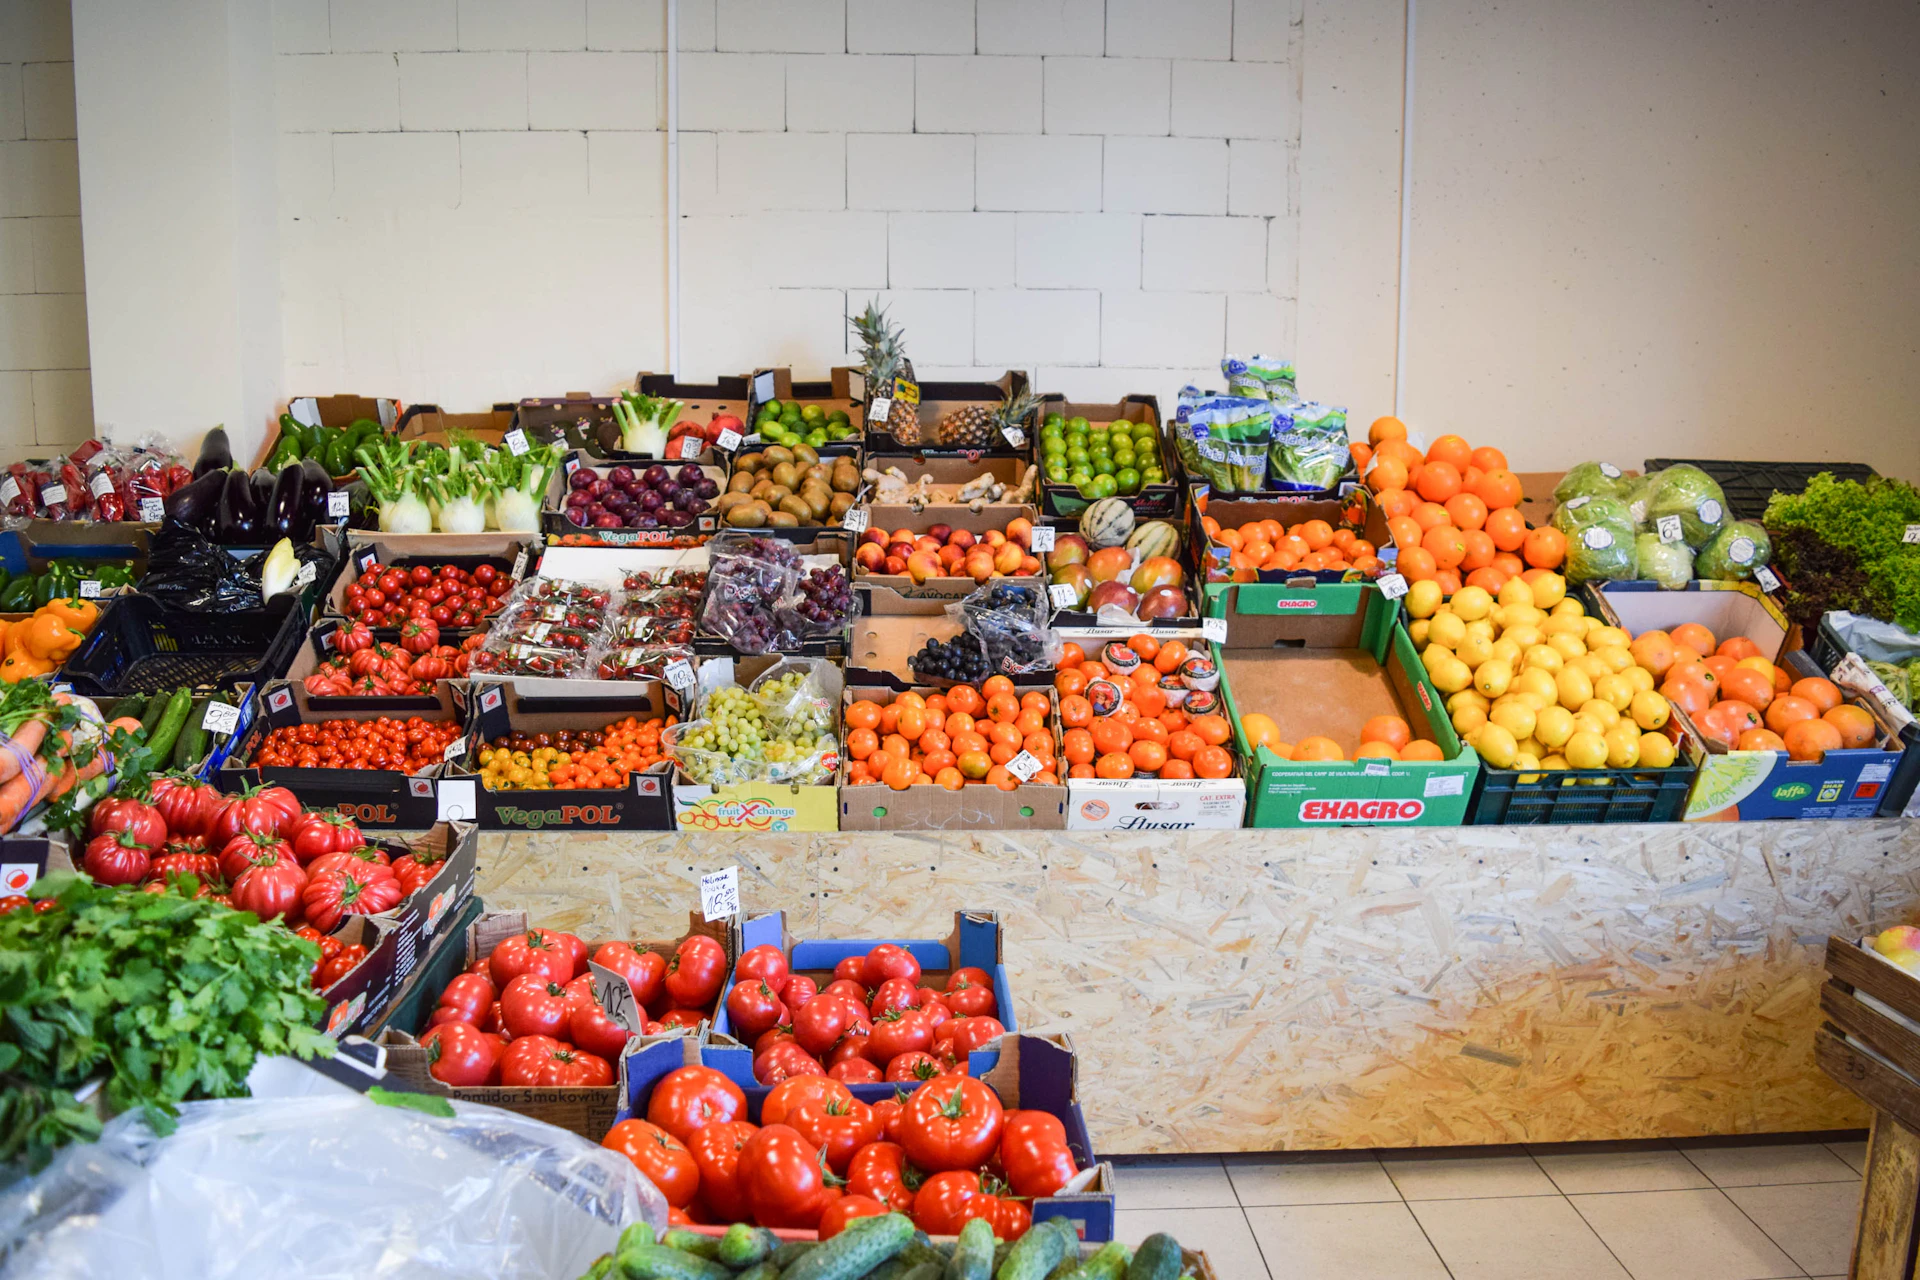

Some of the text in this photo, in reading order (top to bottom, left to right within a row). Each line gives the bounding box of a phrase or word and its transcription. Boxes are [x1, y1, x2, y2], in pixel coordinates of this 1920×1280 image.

[599, 531, 673, 545] VegaPOL
[1279, 600, 1317, 608] EXAGRO
[495, 804, 622, 830] VegaPOL
[1302, 801, 1422, 820] EXAGRO
[453, 1089, 610, 1106] Pomidor Smakowity
